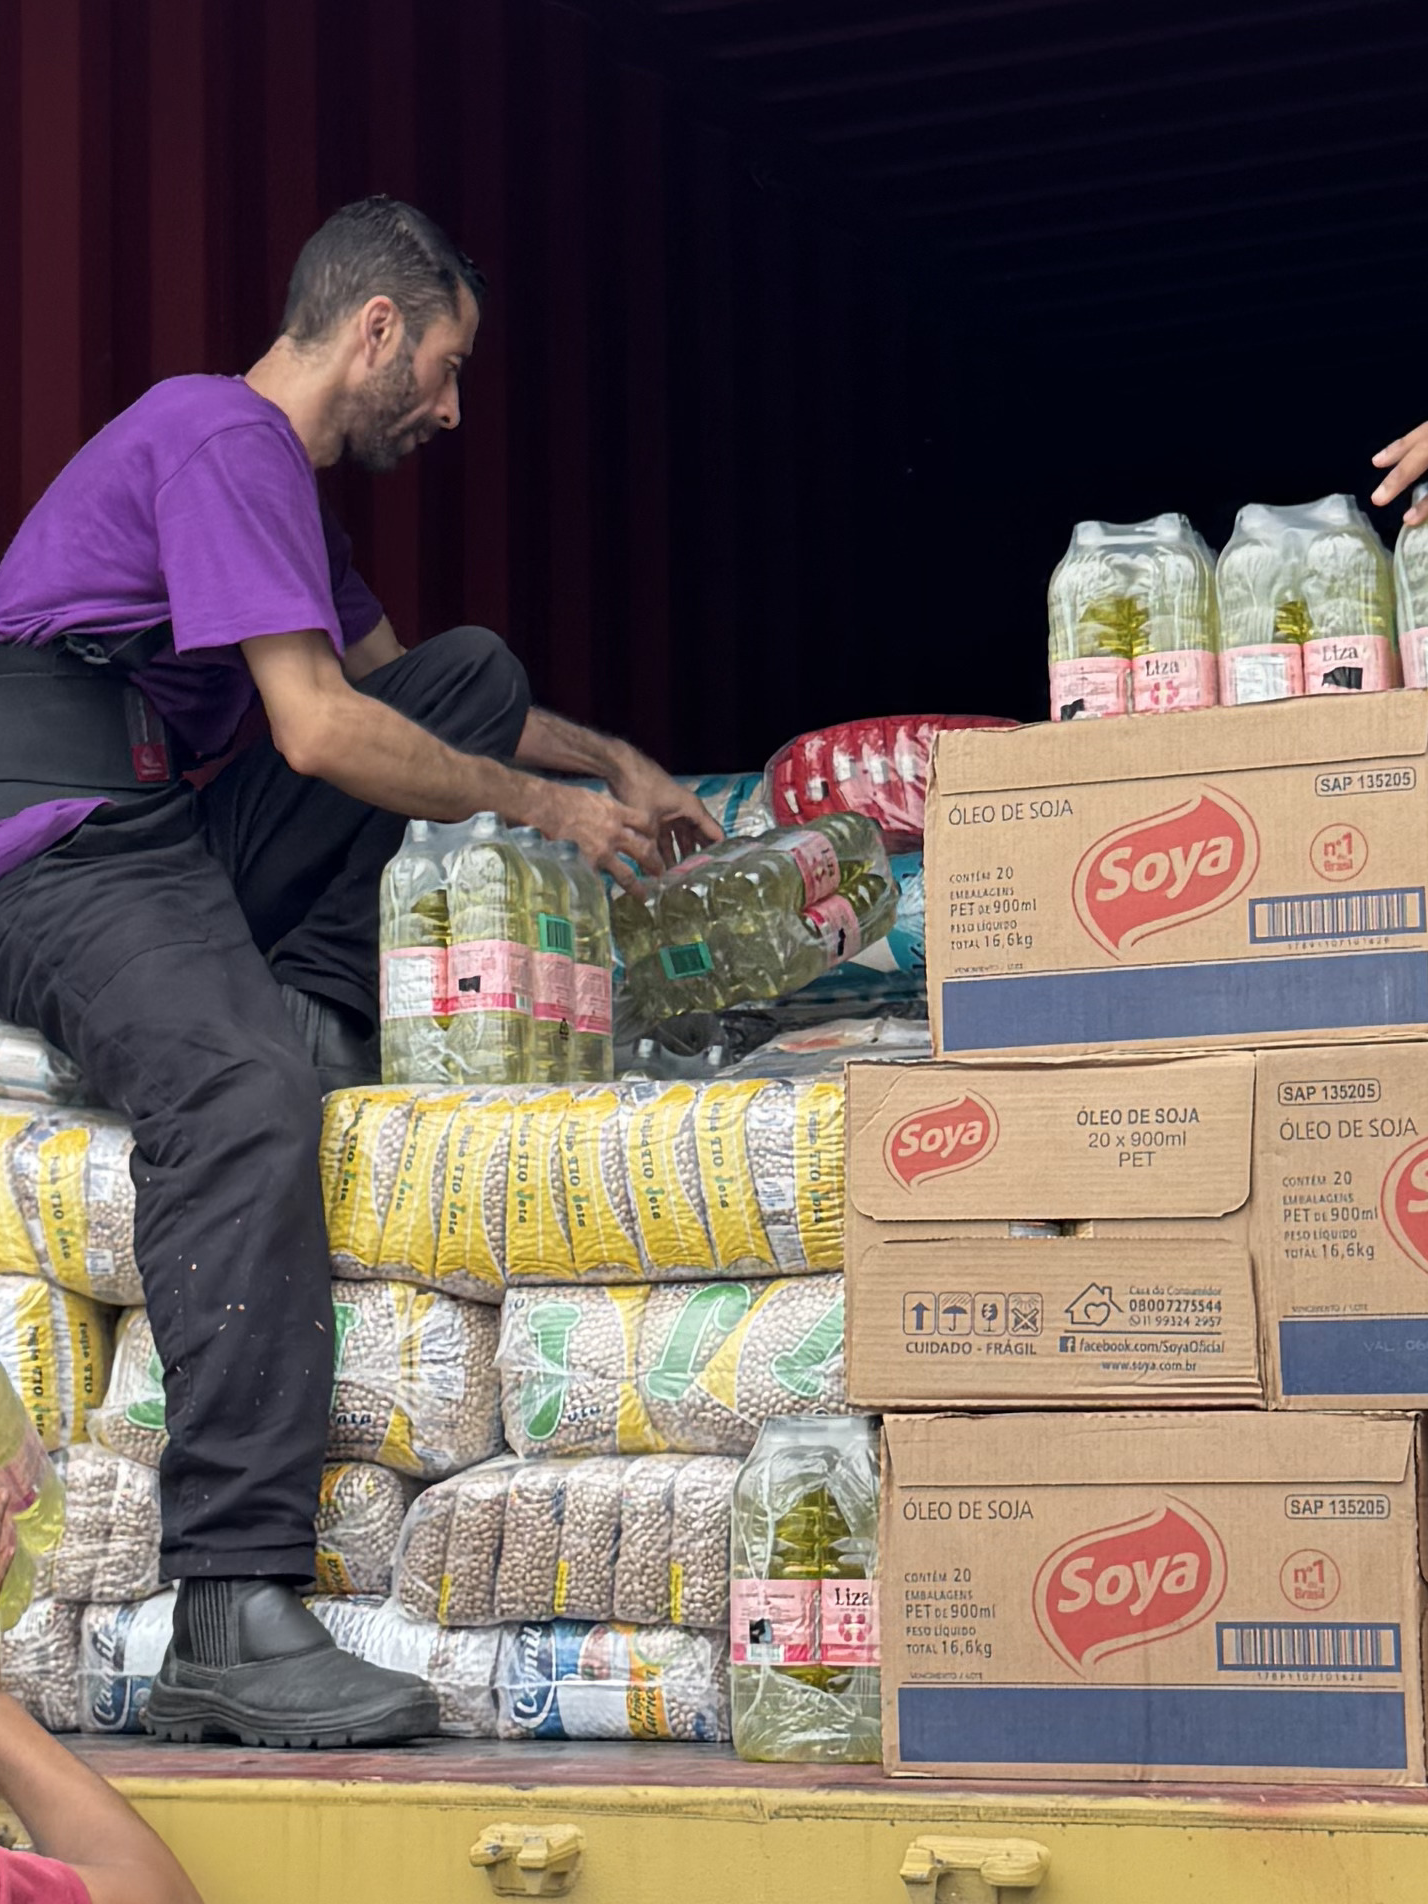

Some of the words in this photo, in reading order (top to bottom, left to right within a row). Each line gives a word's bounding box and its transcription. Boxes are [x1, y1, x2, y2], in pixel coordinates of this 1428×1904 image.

[1320, 777, 1352, 792] SAP
[1358, 772, 1411, 790] 135205
[949, 802, 995, 826] ÓLEO
[1002, 803, 1024, 821] DE
[1030, 800, 1073, 819] SOJA
[996, 866, 1013, 880] 20
[1097, 836, 1233, 901] Soya
[951, 902, 974, 917] PET
[994, 899, 1037, 914] 900ml
[1284, 1086, 1316, 1102] SAP
[1322, 1084, 1375, 1100] 135205
[1077, 1106, 1121, 1126] ÓLEO
[1128, 1109, 1151, 1124] DE
[1156, 1107, 1200, 1124] SOJA
[1280, 1118, 1331, 1140] ÓLEO
[1339, 1119, 1363, 1138] DE
[1369, 1117, 1418, 1137] SOJA
[898, 1120, 983, 1158] Soya
[1089, 1132, 1110, 1148] 20
[1116, 1136, 1126, 1147] x
[1130, 1131, 1186, 1147] 900ml
[517, 1152, 529, 1182] TIO
[641, 1148, 653, 1179] TIO
[1119, 1151, 1156, 1167] PET
[1333, 1171, 1352, 1185] 20
[1284, 1209, 1310, 1222] PET
[1331, 1207, 1378, 1221] 900ml
[1322, 1245, 1374, 1260] 16,6kg
[1130, 1299, 1221, 1312] 08007275544
[906, 1341, 972, 1355] CUIDADO
[986, 1339, 1037, 1355] FRÁGIL
[1080, 1338, 1224, 1355] facebook.com/SoyaOficial
[1101, 1361, 1196, 1374] www.soya.com.br
[903, 1498, 952, 1520] ÓLEO
[959, 1501, 982, 1520] DE
[988, 1500, 1033, 1519] SOJA
[1291, 1500, 1324, 1514] SAP
[1329, 1501, 1384, 1515] 135205
[953, 1568, 971, 1582] 20
[1057, 1552, 1199, 1615] Soya
[835, 1588, 871, 1606] Liza
[906, 1604, 931, 1618] PET
[951, 1604, 995, 1618] 900ml
[942, 1640, 992, 1658] 16,6kg
